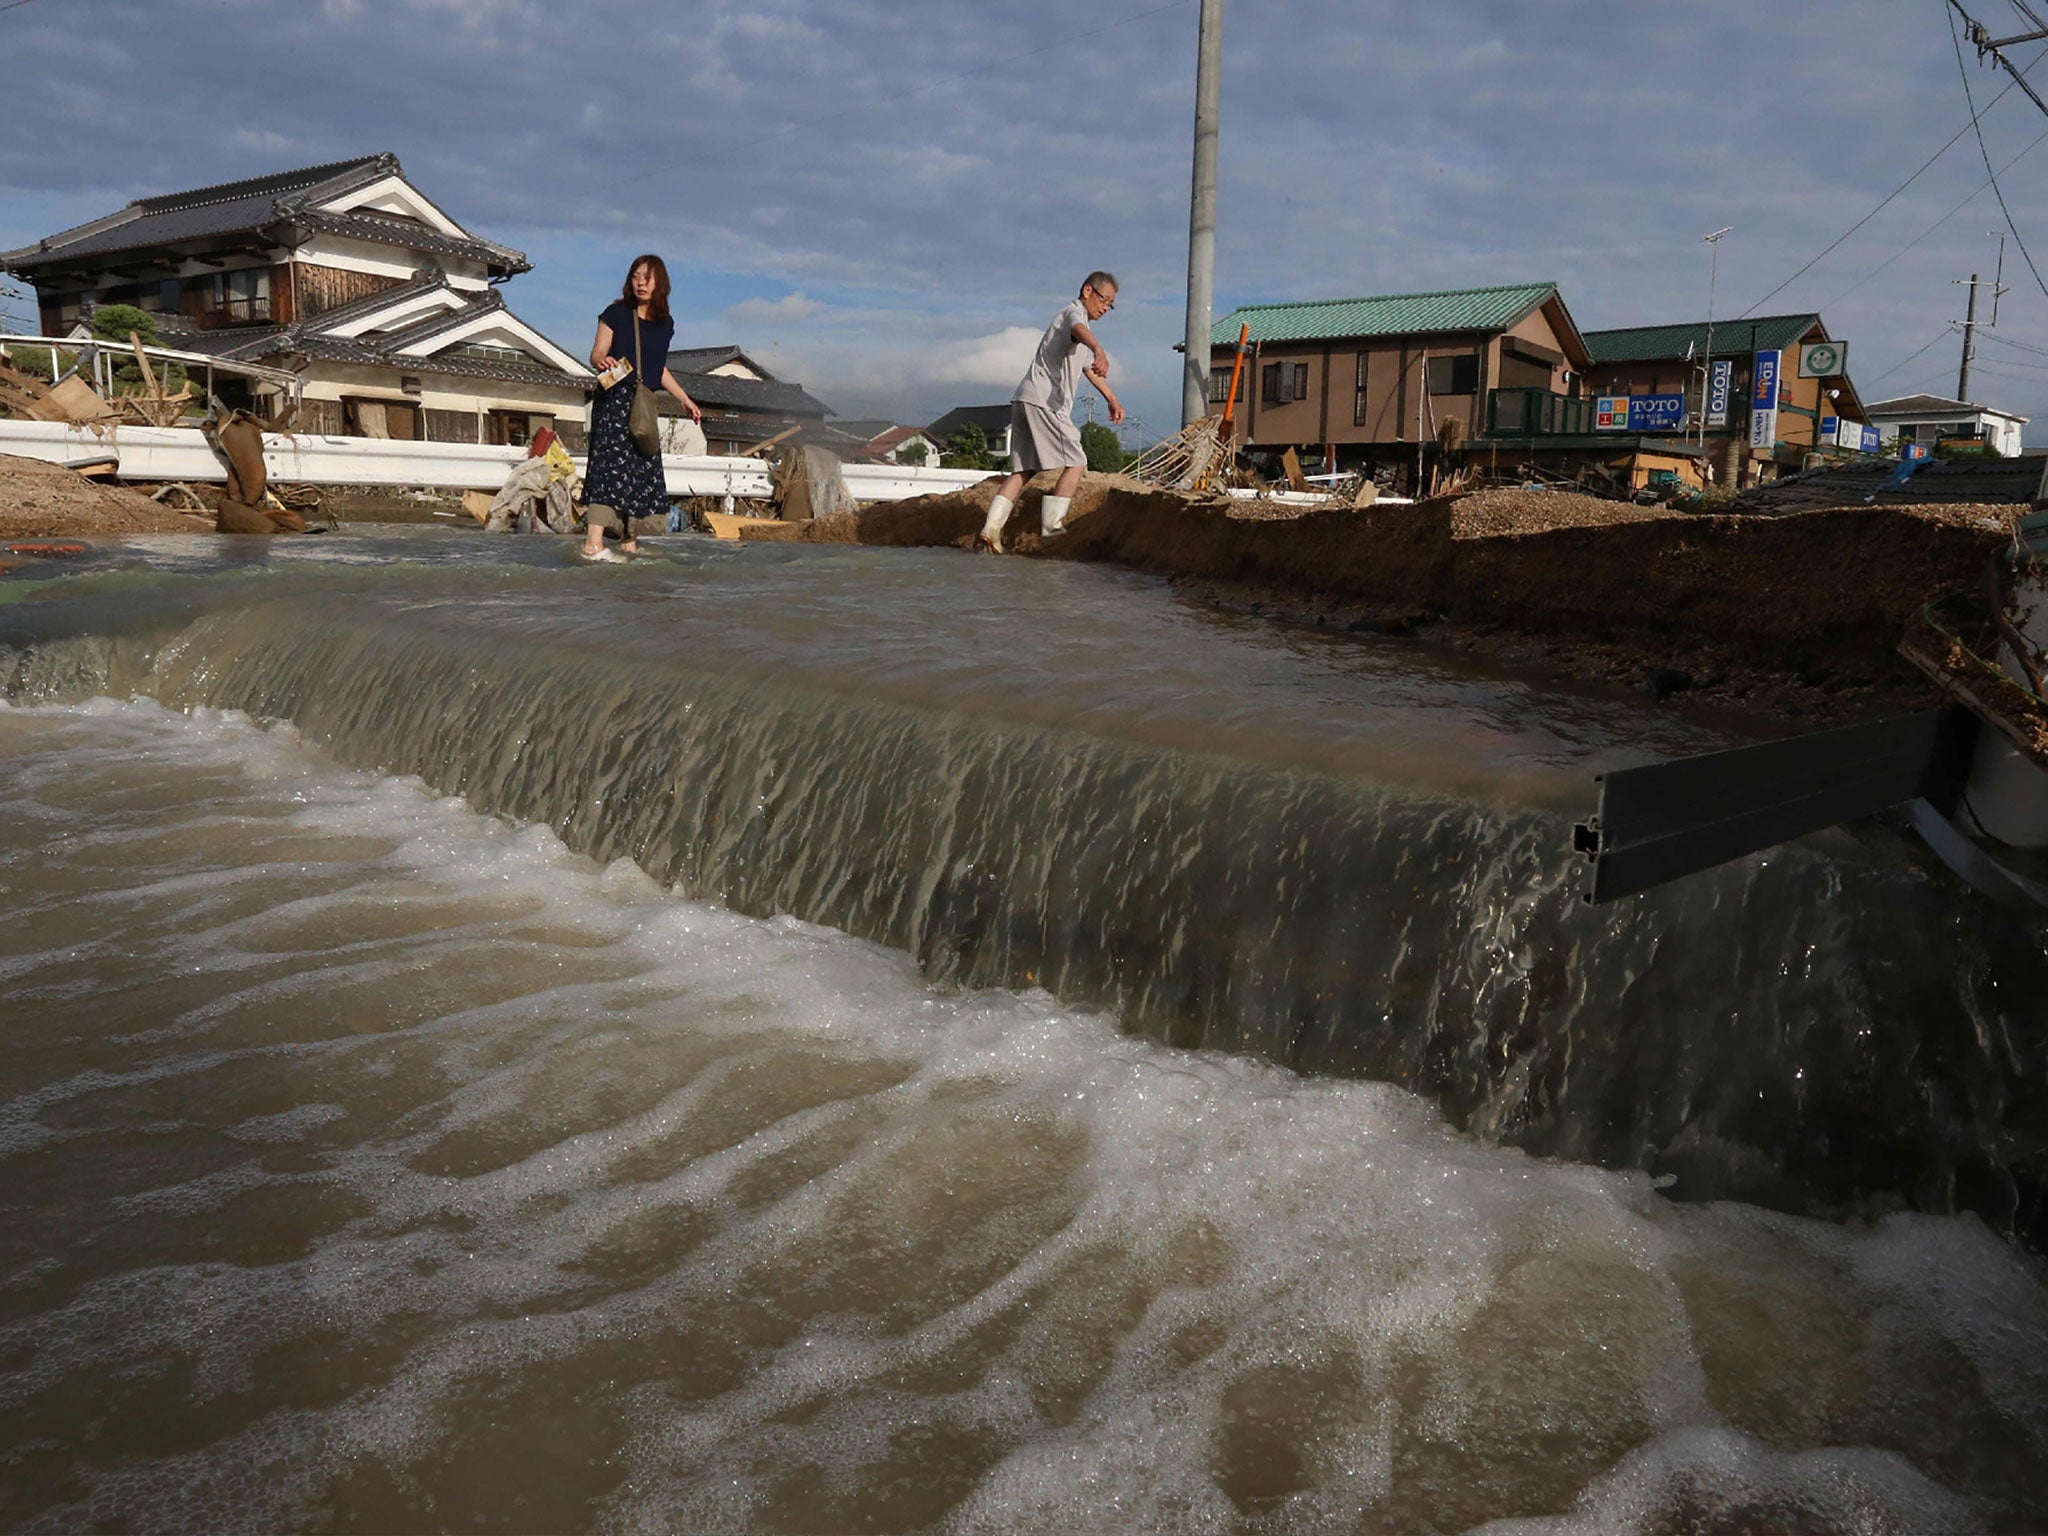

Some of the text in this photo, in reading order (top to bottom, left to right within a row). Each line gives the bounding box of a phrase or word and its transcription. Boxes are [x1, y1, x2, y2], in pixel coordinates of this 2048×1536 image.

[1712, 365, 1727, 412] TOTO
[1757, 361, 1774, 399] EDION
[1632, 399, 1679, 412] TOTO
